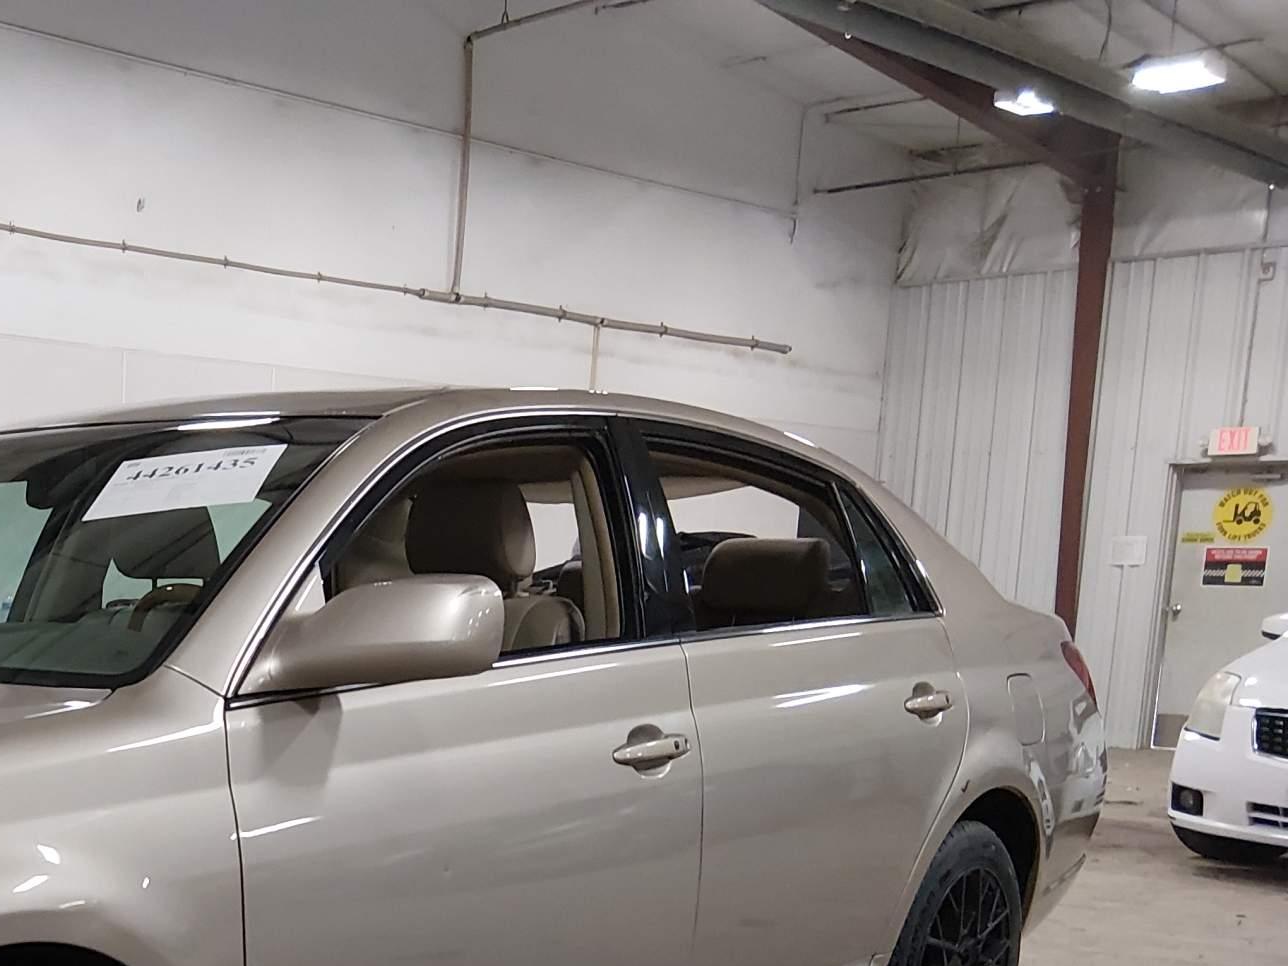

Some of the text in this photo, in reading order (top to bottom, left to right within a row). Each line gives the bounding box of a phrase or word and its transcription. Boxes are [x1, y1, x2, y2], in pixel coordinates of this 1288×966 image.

[1218, 428, 1251, 451] EXIT
[126, 456, 258, 481] 44261435
[1218, 488, 1269, 508] WATCH OUT FOR
[1216, 522, 1228, 537] FORK
[1244, 522, 1266, 541] TRUCKS
